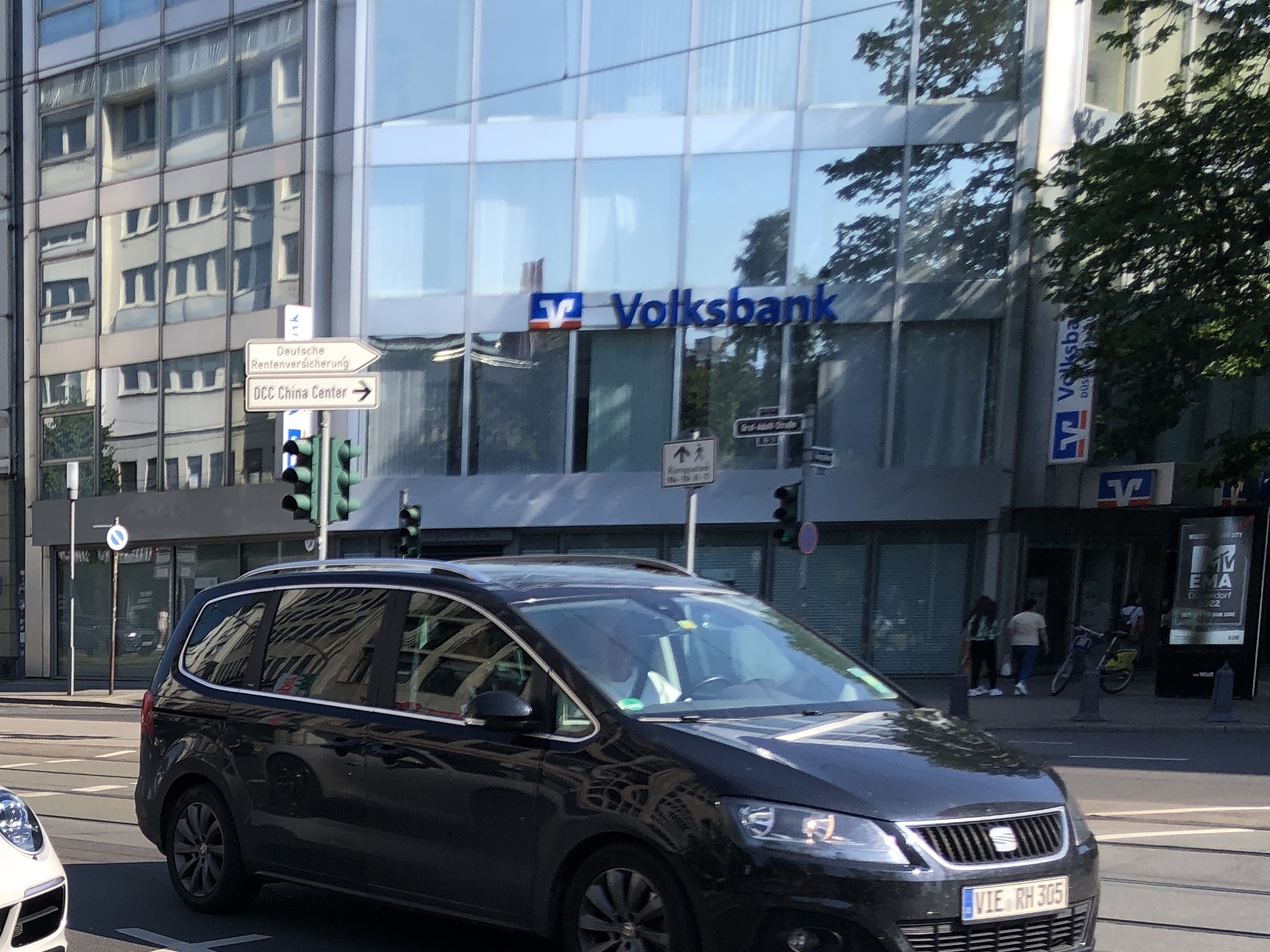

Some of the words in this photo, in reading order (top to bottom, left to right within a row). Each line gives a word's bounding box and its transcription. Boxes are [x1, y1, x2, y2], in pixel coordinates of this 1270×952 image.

[612, 284, 838, 328] Volksbank
[277, 346, 325, 356] Deutsche
[251, 356, 350, 370] Rentenversicherung
[254, 386, 275, 400] DCC
[278, 385, 308, 400] China
[312, 385, 348, 400] Center
[974, 889, 1004, 914] VIE
[1015, 885, 1035, 911] RH
[1038, 881, 1064, 907] 305
